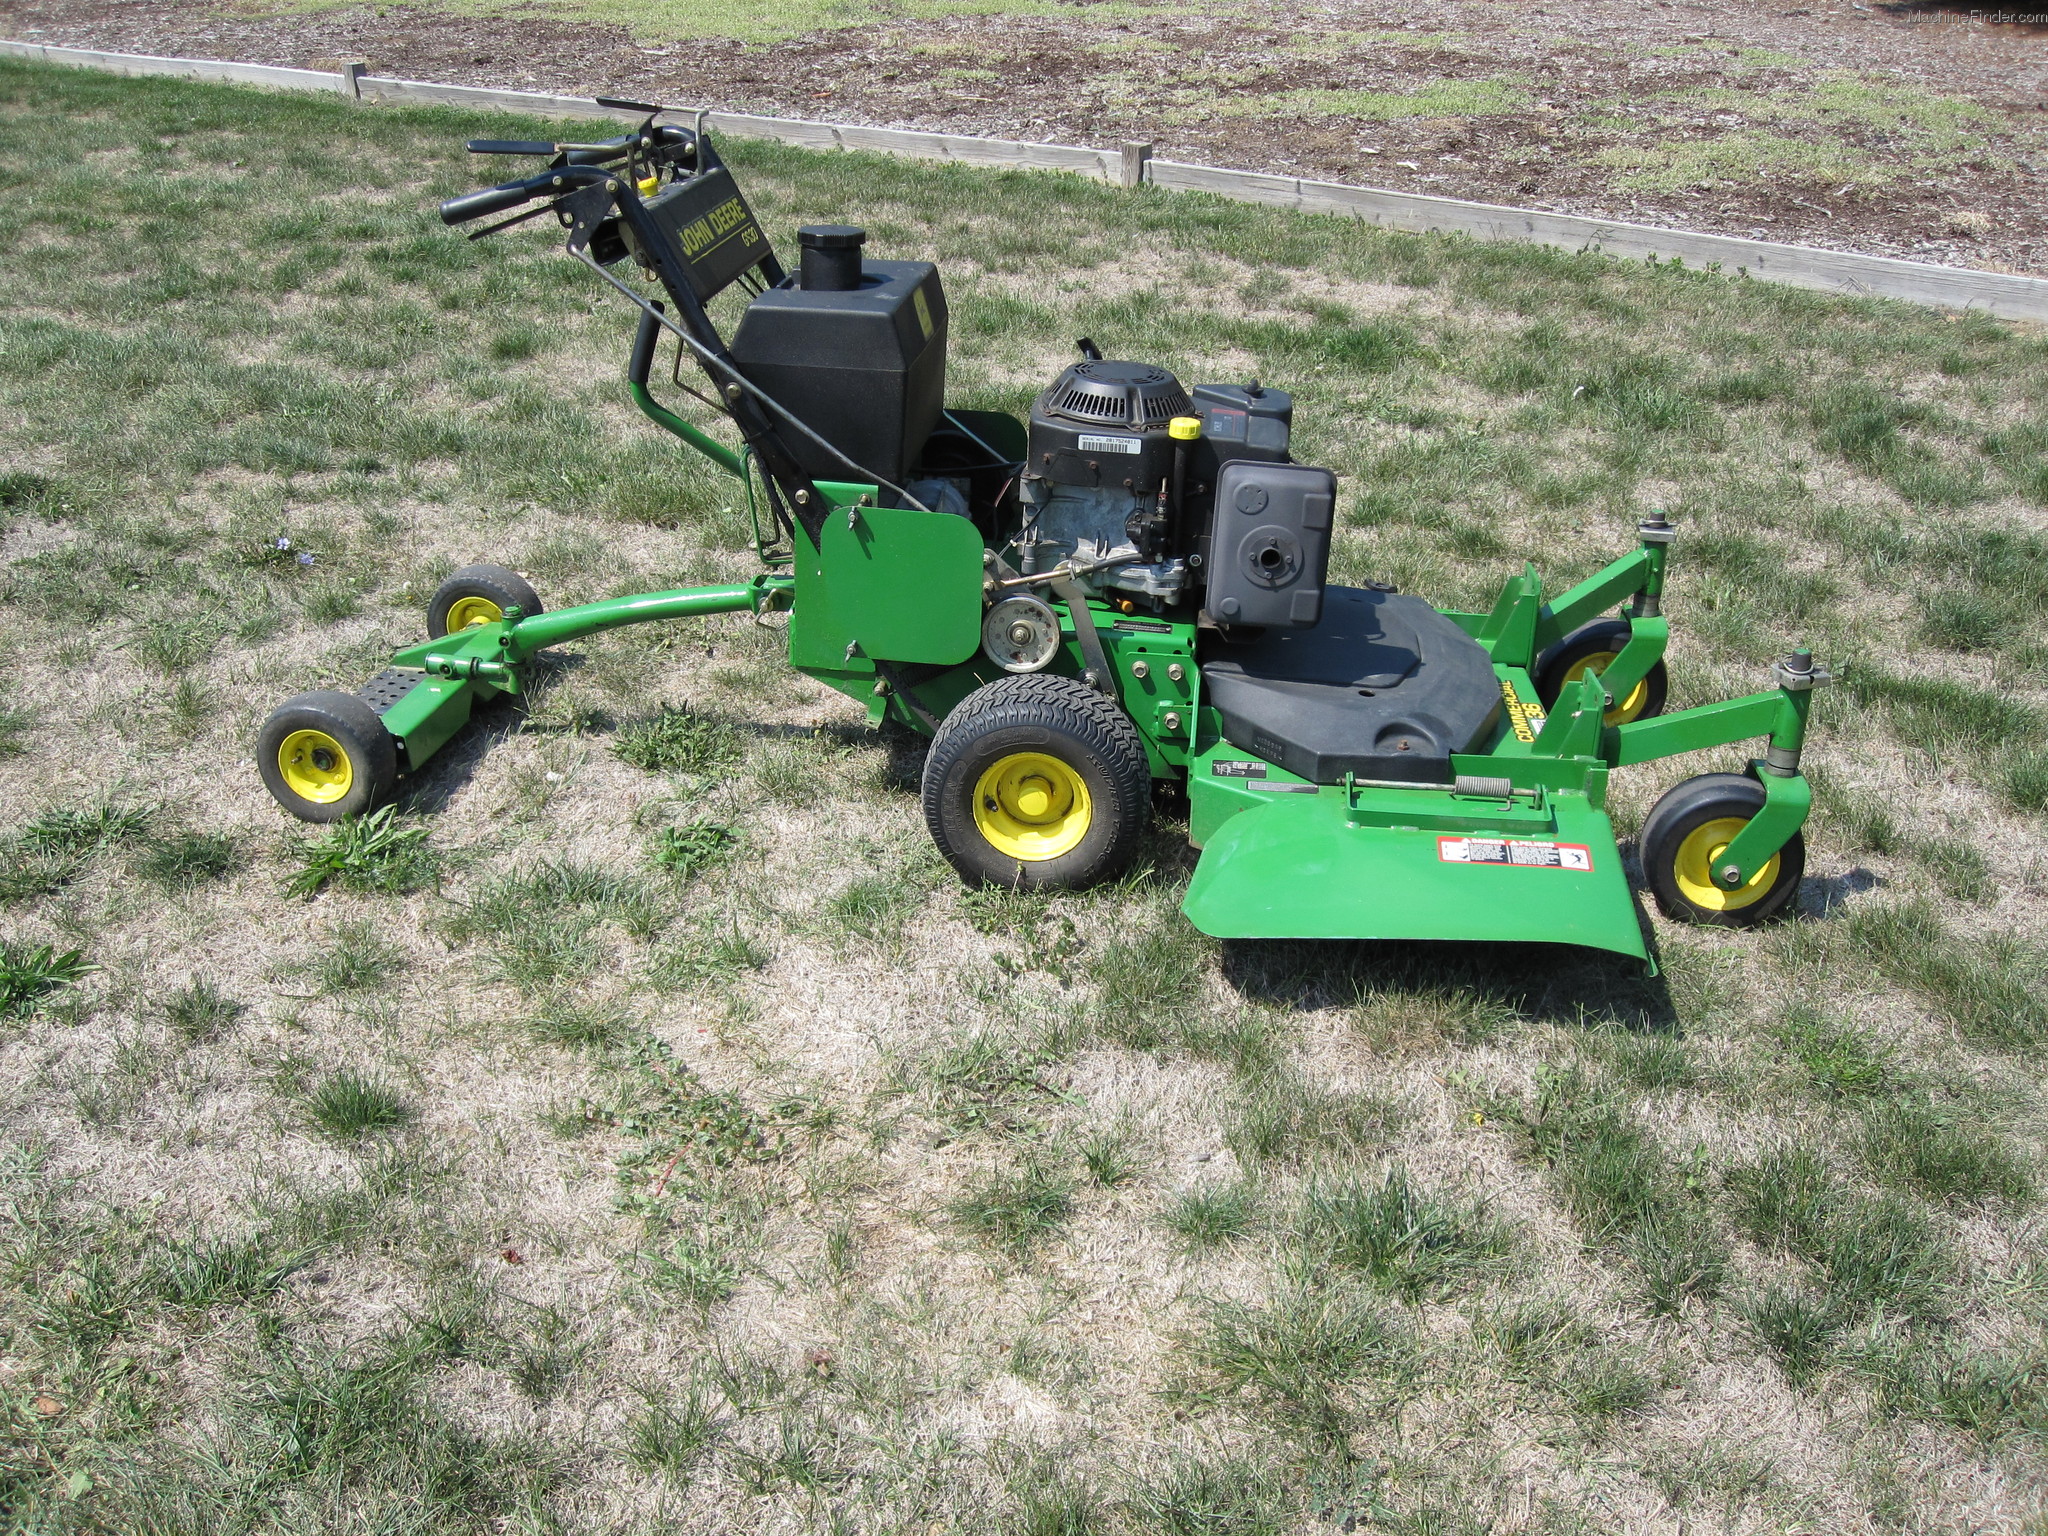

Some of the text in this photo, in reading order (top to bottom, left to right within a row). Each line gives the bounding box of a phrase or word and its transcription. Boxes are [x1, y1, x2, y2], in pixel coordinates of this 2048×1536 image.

[679, 197, 747, 256] JOHN DEERE
[1502, 680, 1535, 743] COMMERCIAL
[1521, 703, 1546, 720] 36
[1086, 754, 1121, 812] SUPER
